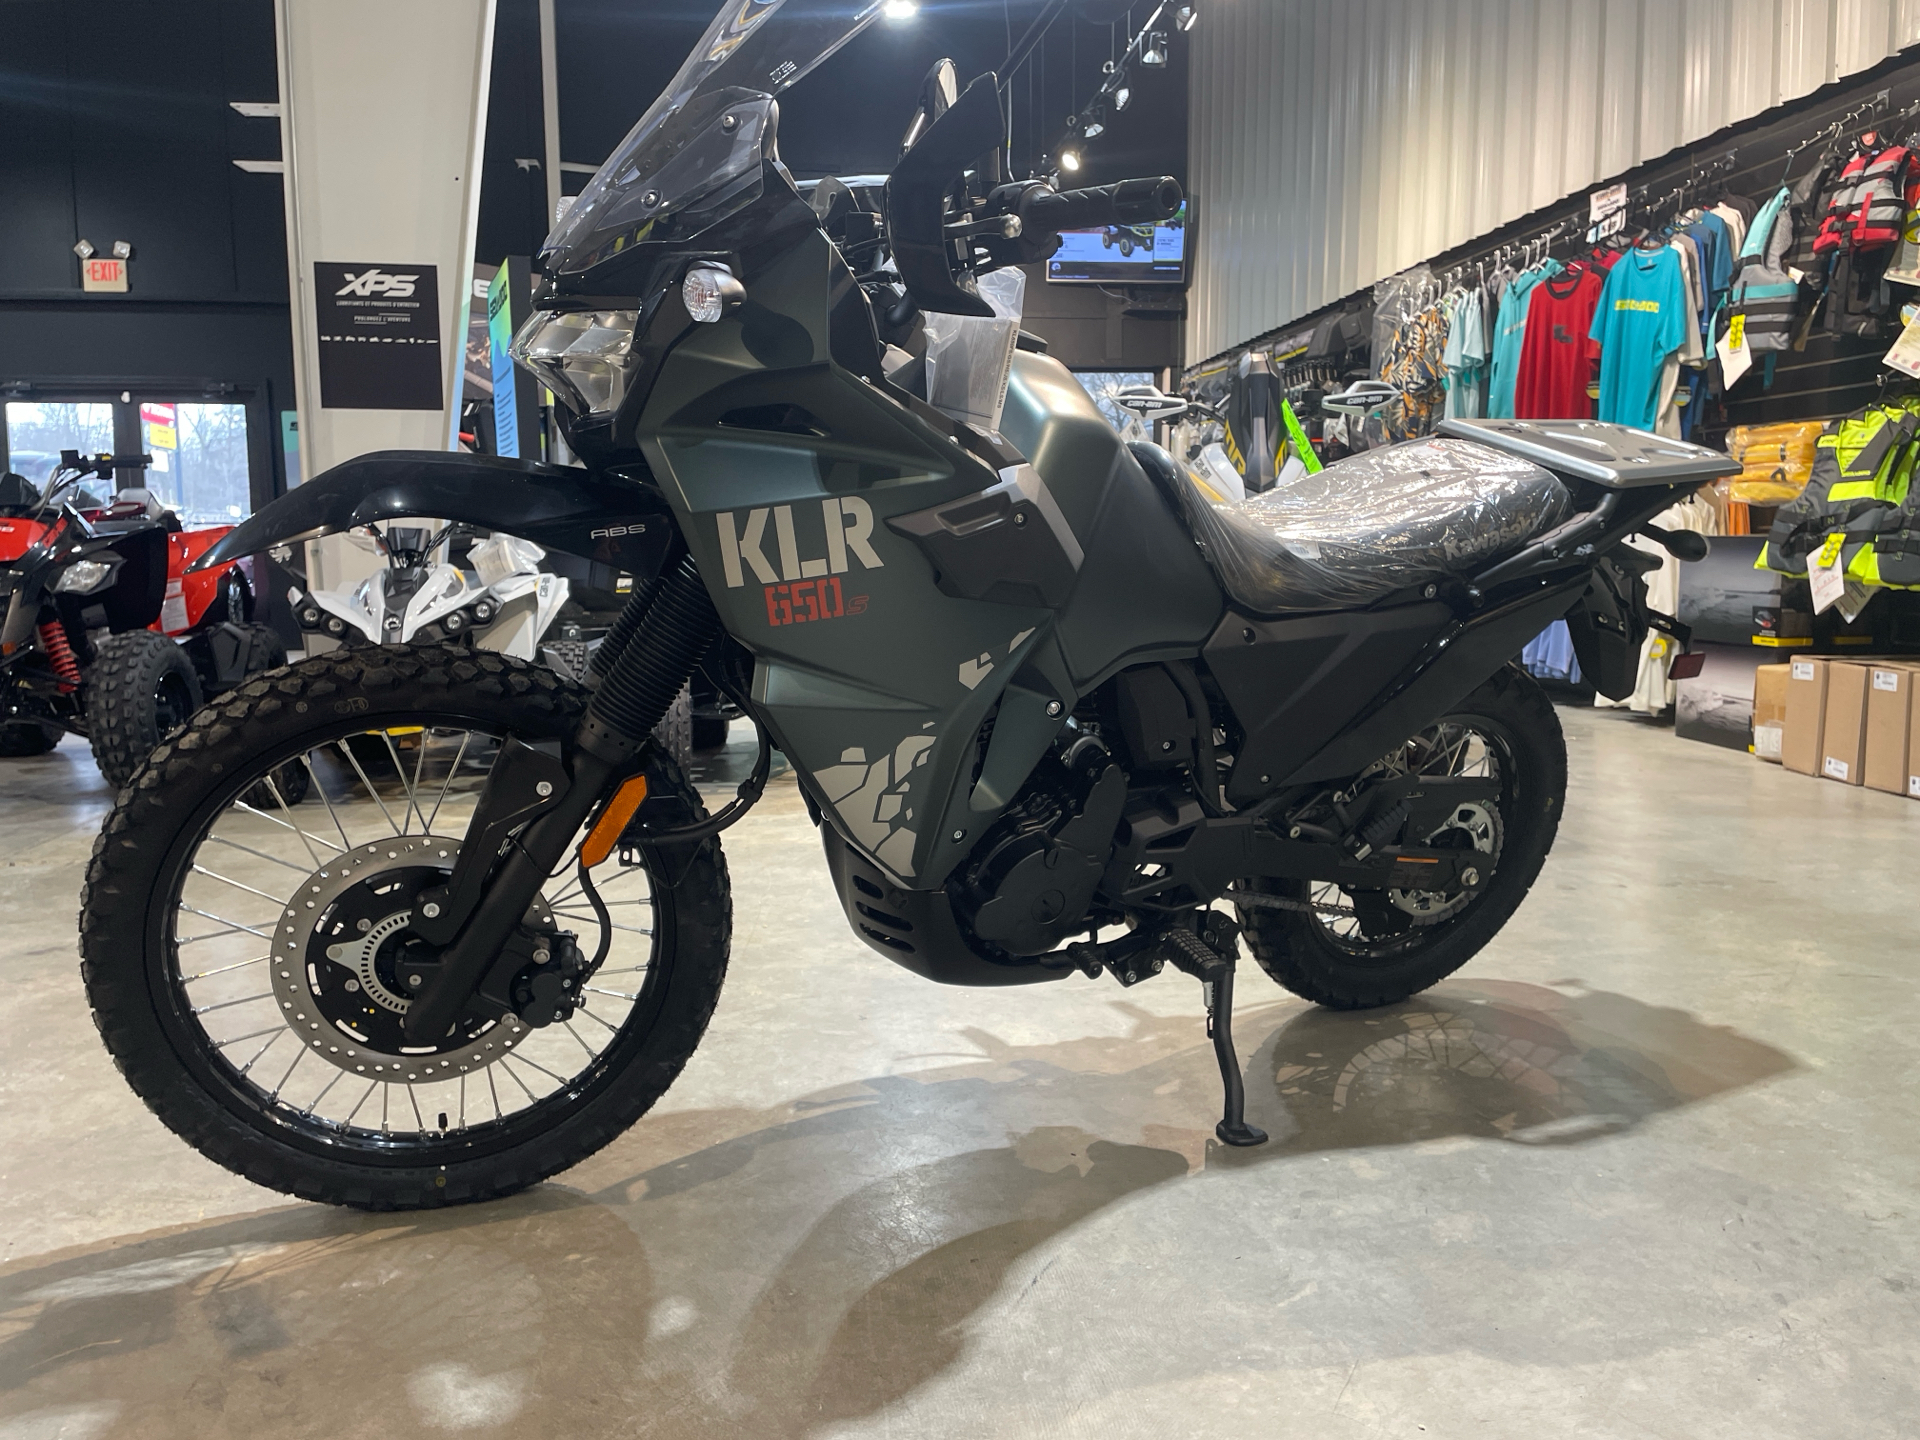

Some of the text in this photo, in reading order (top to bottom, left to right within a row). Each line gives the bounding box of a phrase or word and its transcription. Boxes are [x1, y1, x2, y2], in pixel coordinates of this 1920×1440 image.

[91, 261, 118, 281] EXIT
[335, 269, 420, 297] XPS
[590, 524, 646, 539] ABS
[716, 496, 885, 588] KLR
[1443, 511, 1538, 562] Kawasaki
